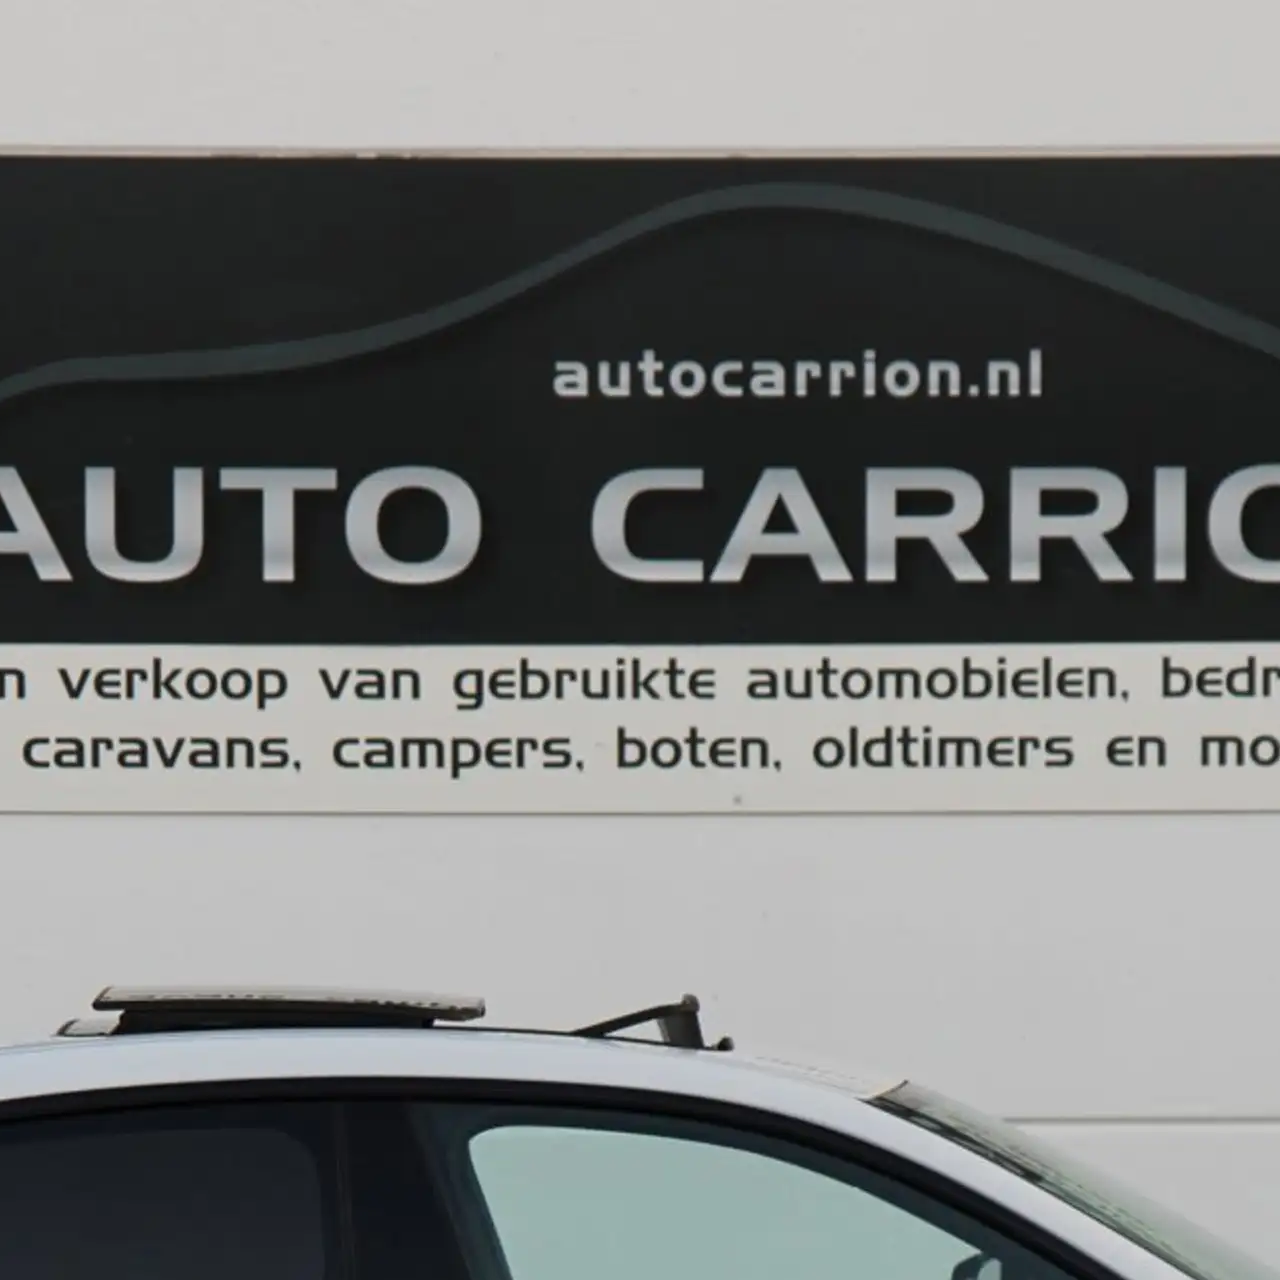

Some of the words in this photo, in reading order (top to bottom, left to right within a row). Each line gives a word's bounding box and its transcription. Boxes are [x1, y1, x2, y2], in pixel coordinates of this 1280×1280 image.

[553, 349, 1042, 398] autocarrion.nl
[57, 657, 288, 710] verkoop
[318, 668, 421, 700] van
[453, 657, 715, 711] gebruikte
[746, 656, 1131, 702] automobielen,
[22, 737, 301, 772] caravans,
[332, 737, 584, 780] campers,
[617, 726, 782, 771] boten,
[812, 725, 1074, 769] oldtimers
[1106, 736, 1166, 767] en
